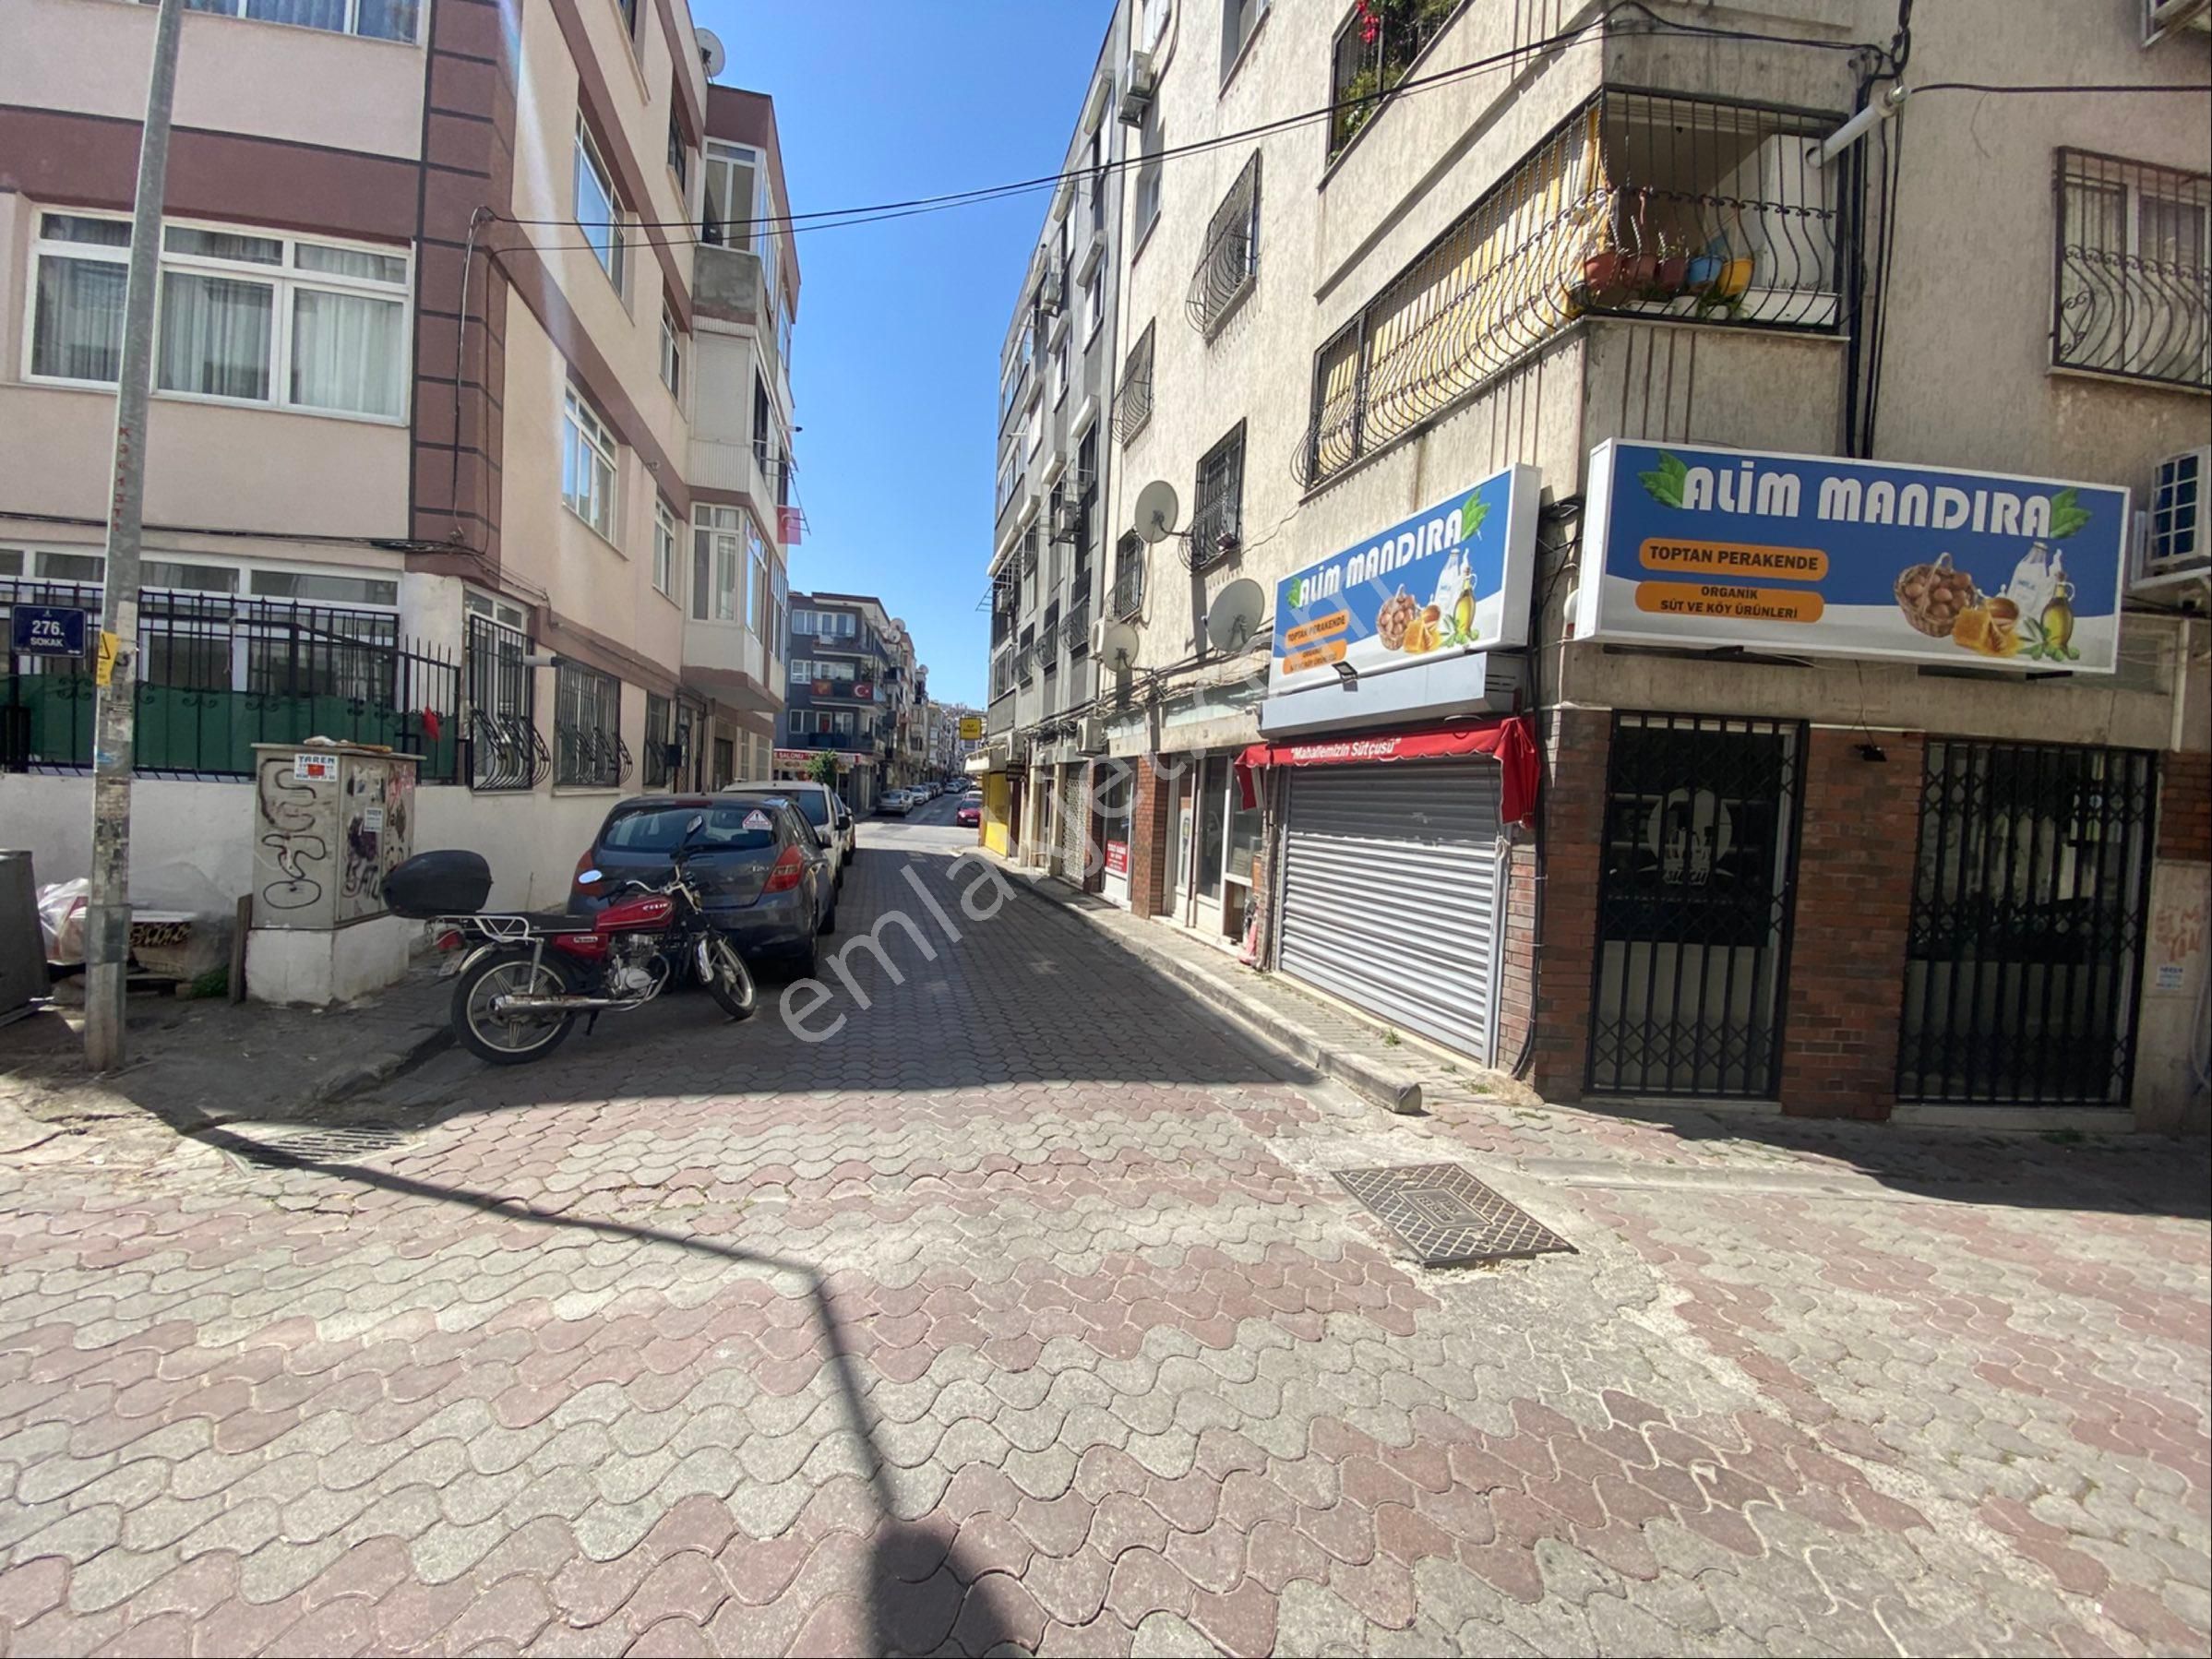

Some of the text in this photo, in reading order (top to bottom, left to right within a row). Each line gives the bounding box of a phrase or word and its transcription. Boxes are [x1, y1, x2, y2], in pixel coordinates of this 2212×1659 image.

[1681, 460, 2051, 538] ALİM MANDIRA
[1299, 508, 1463, 607] ALİM MANDIRA
[1650, 545, 1819, 570] TOPTAN PERAKENDE
[1660, 598, 1684, 611] SÜT
[1688, 602, 1704, 613] VE
[1707, 602, 1732, 614] KÖY
[31, 620, 65, 636] 276.
[30, 637, 64, 647] SOKAK
